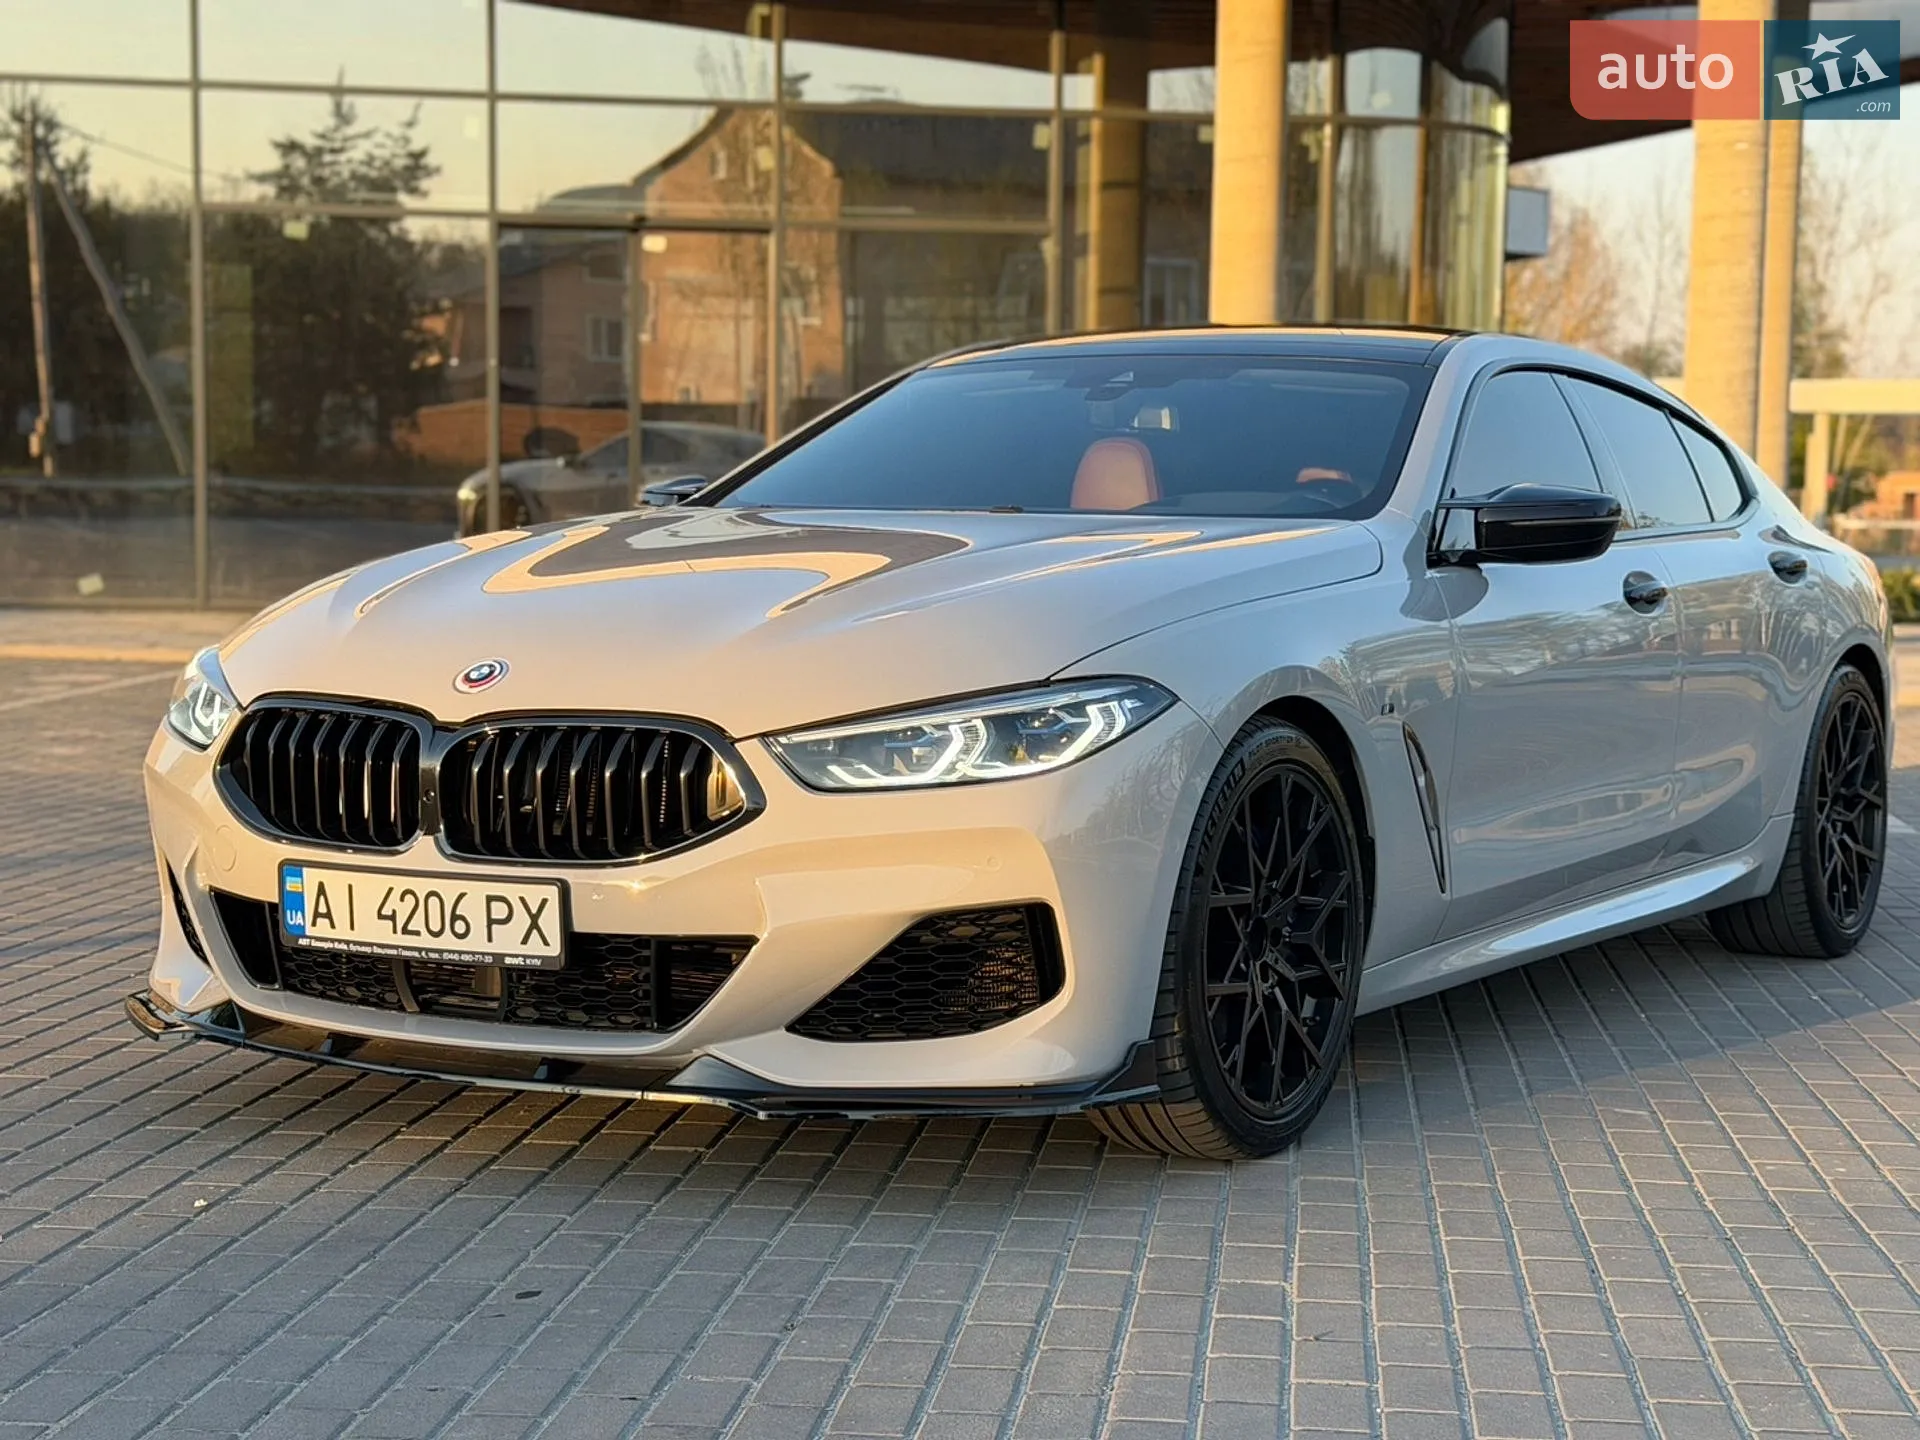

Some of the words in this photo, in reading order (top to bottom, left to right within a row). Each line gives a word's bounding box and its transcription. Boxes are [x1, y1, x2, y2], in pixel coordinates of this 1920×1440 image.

[286, 910, 304, 926] UA
[311, 881, 355, 931] AI
[377, 886, 471, 940] 4206
[485, 894, 551, 947] PX
